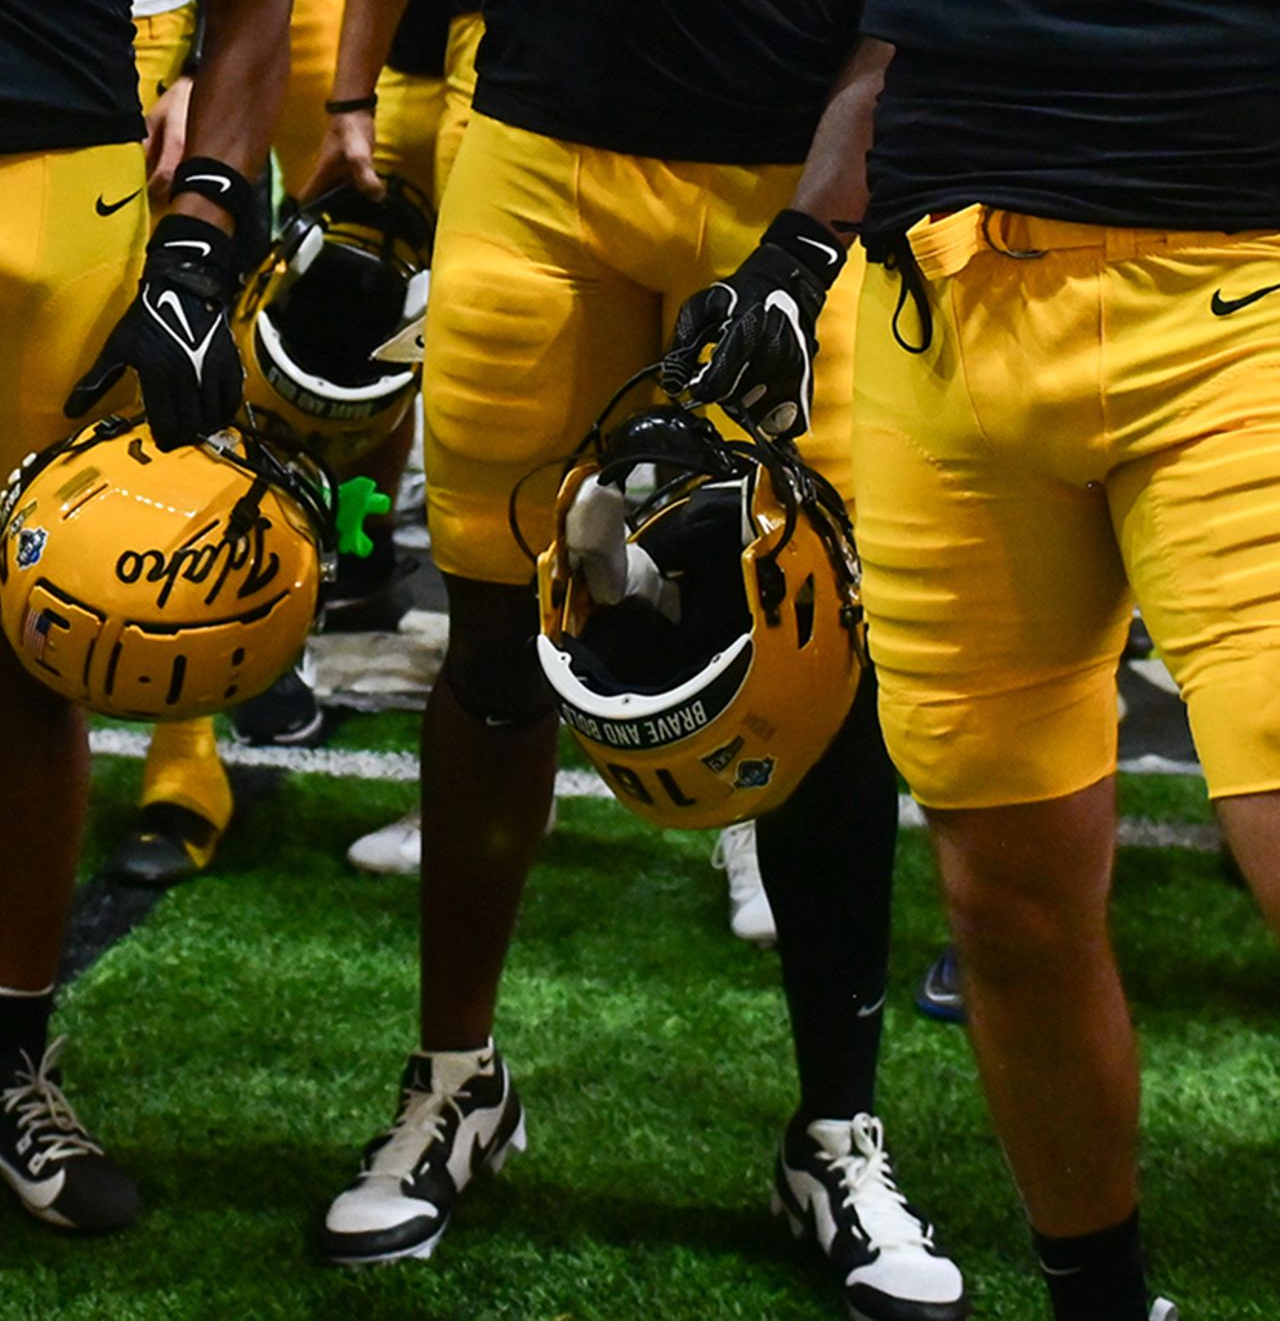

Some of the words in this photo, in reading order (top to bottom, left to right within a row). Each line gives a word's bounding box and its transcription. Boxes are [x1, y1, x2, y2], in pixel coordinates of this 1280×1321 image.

[115, 515, 280, 610] Idaho
[605, 717, 643, 747] AND
[648, 699, 708, 744] BRAVE
